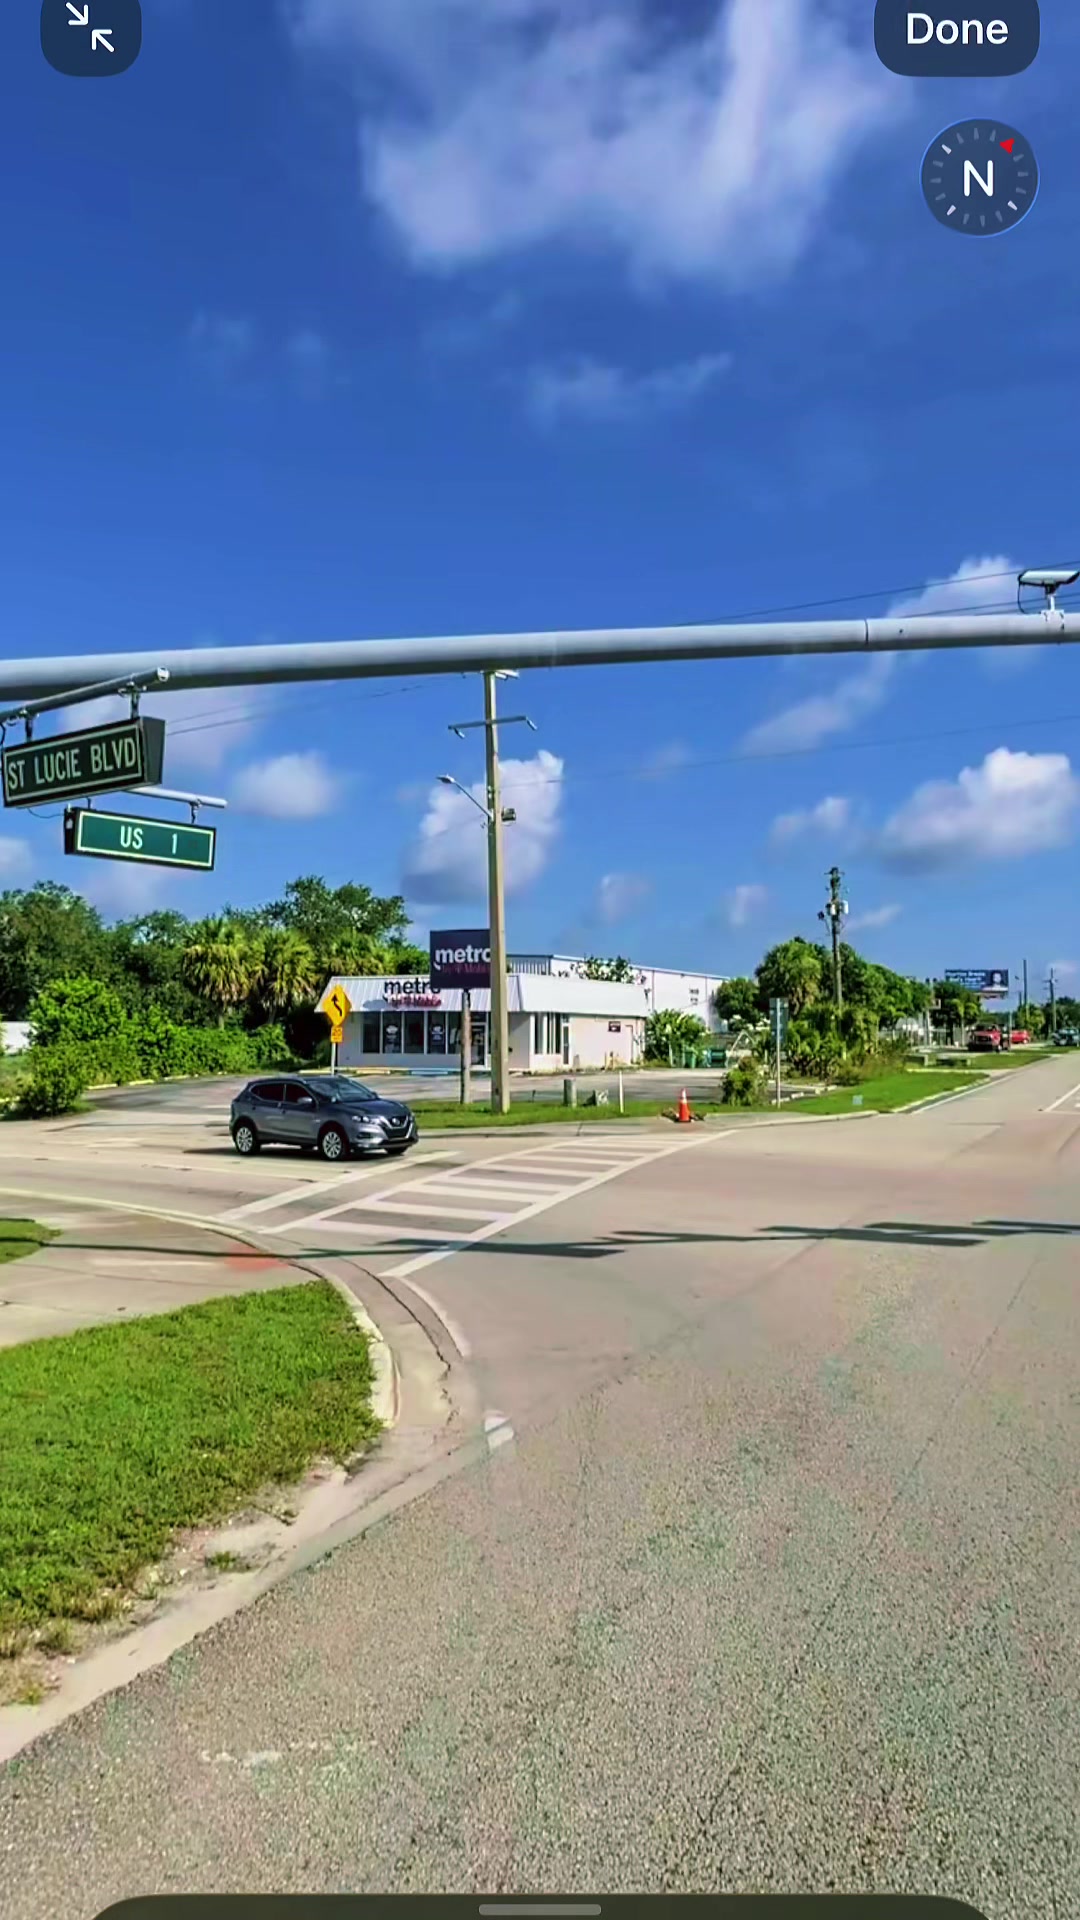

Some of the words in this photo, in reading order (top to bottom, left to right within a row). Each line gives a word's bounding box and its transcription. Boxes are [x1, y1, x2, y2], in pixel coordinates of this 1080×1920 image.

[8, 760, 25, 789] ST
[34, 748, 81, 785] LUCIE
[90, 737, 136, 774] BLVD
[120, 825, 143, 850] US
[171, 833, 178, 855] 1
